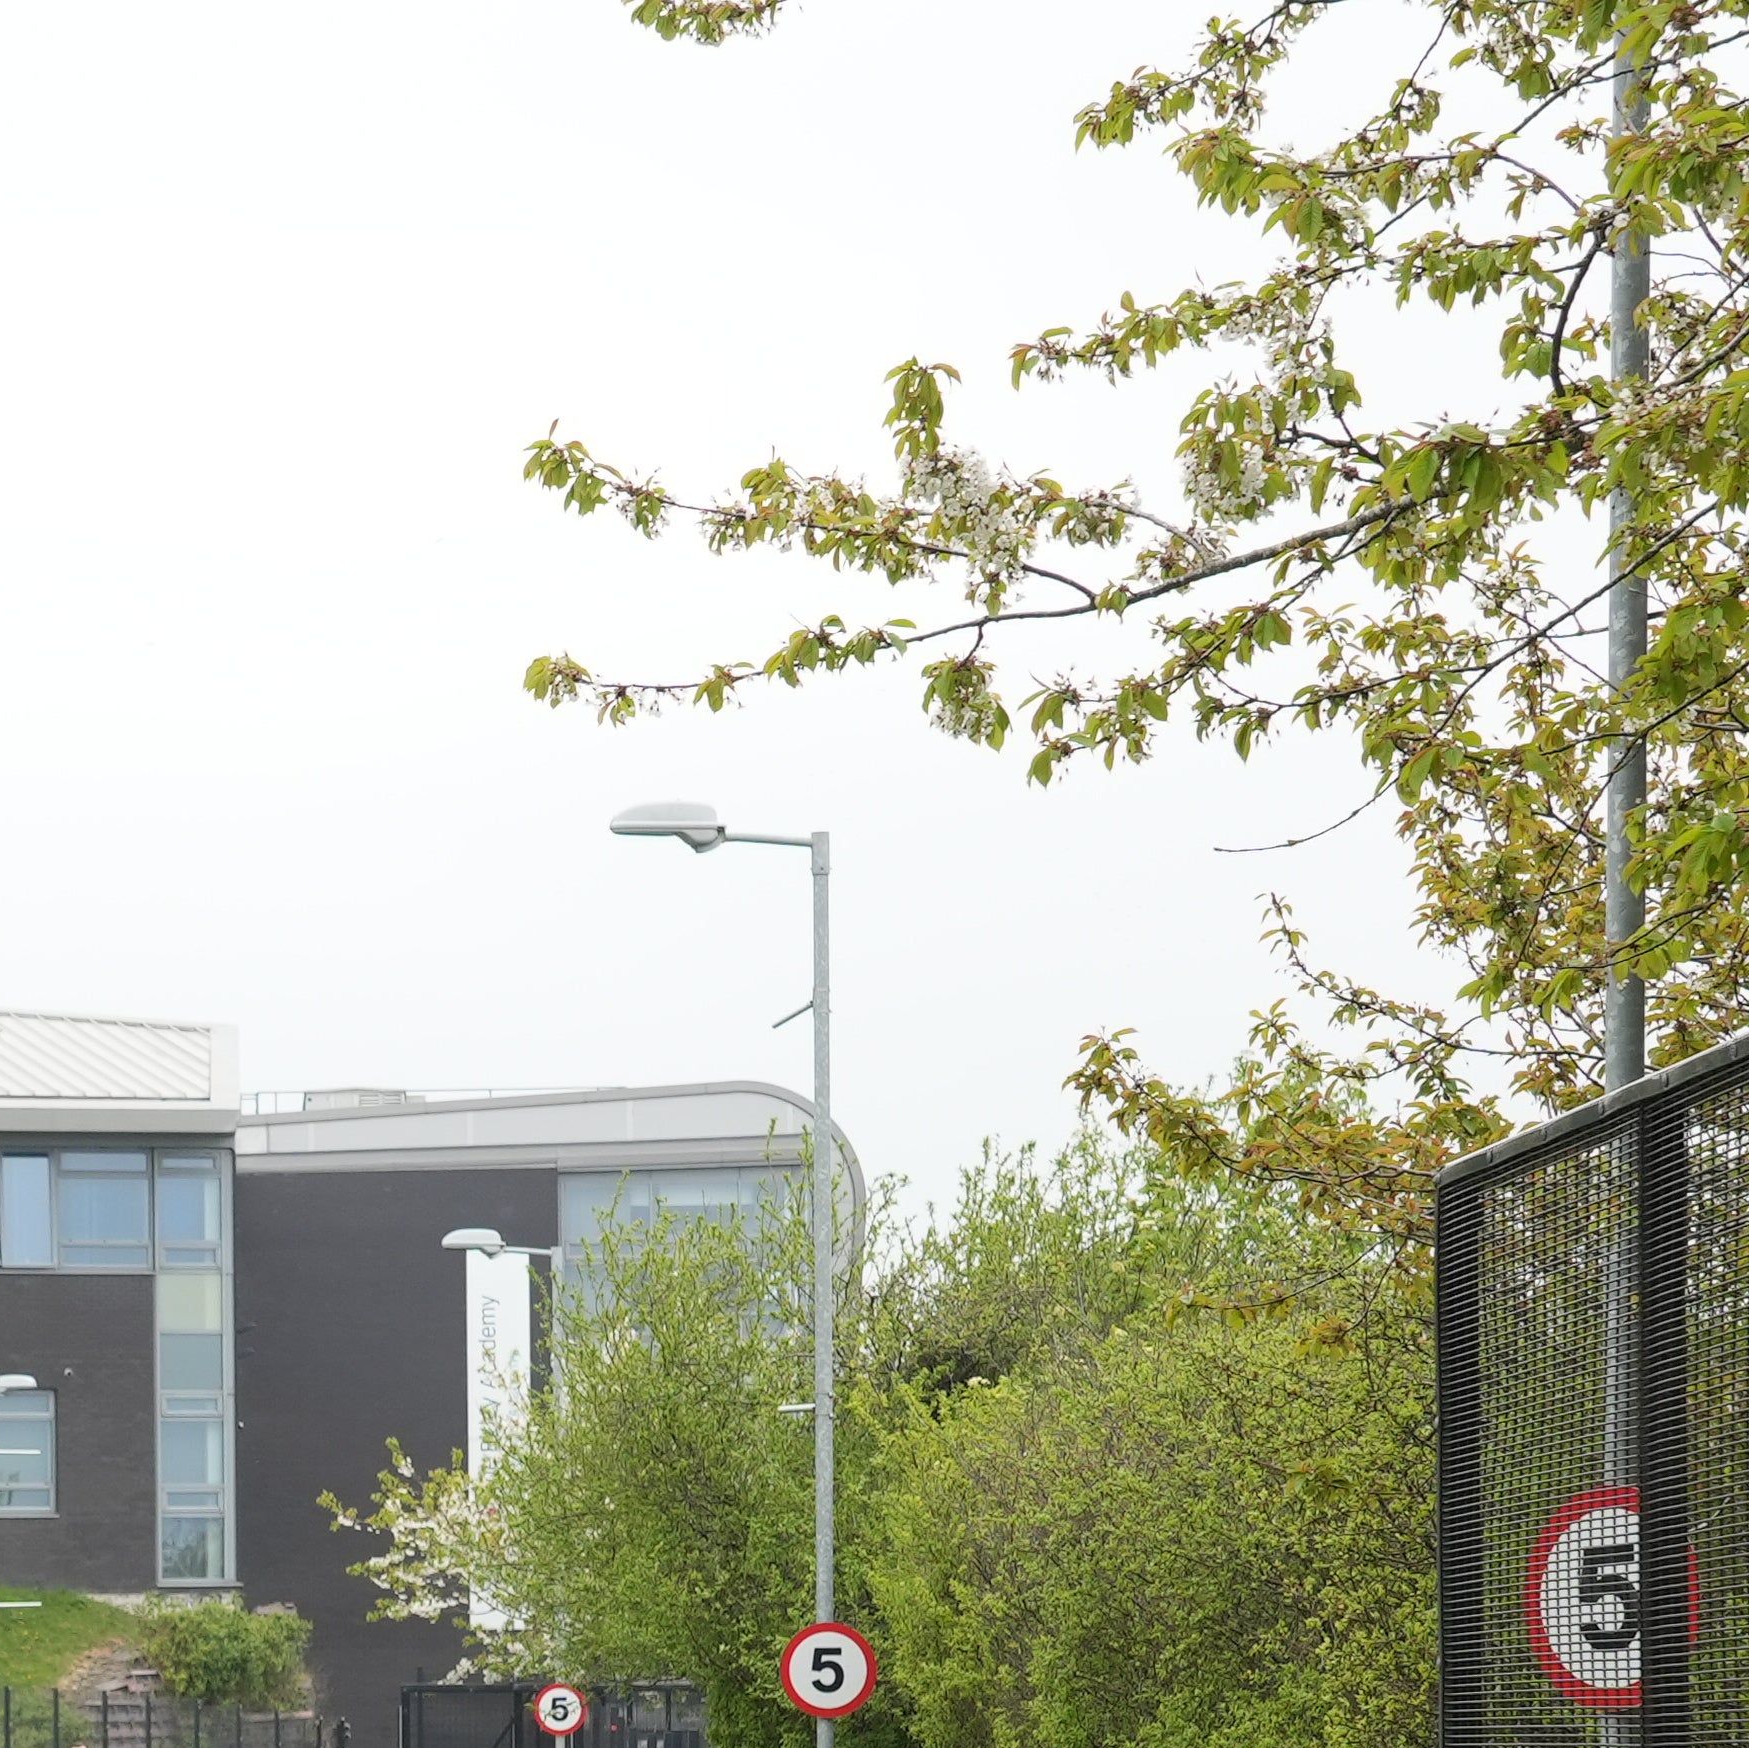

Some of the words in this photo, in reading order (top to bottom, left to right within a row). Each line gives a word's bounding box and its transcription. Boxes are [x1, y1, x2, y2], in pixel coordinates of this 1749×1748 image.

[1579, 1544, 1639, 1650] 5
[811, 1647, 844, 1693] 5
[551, 1697, 569, 1721] 5
